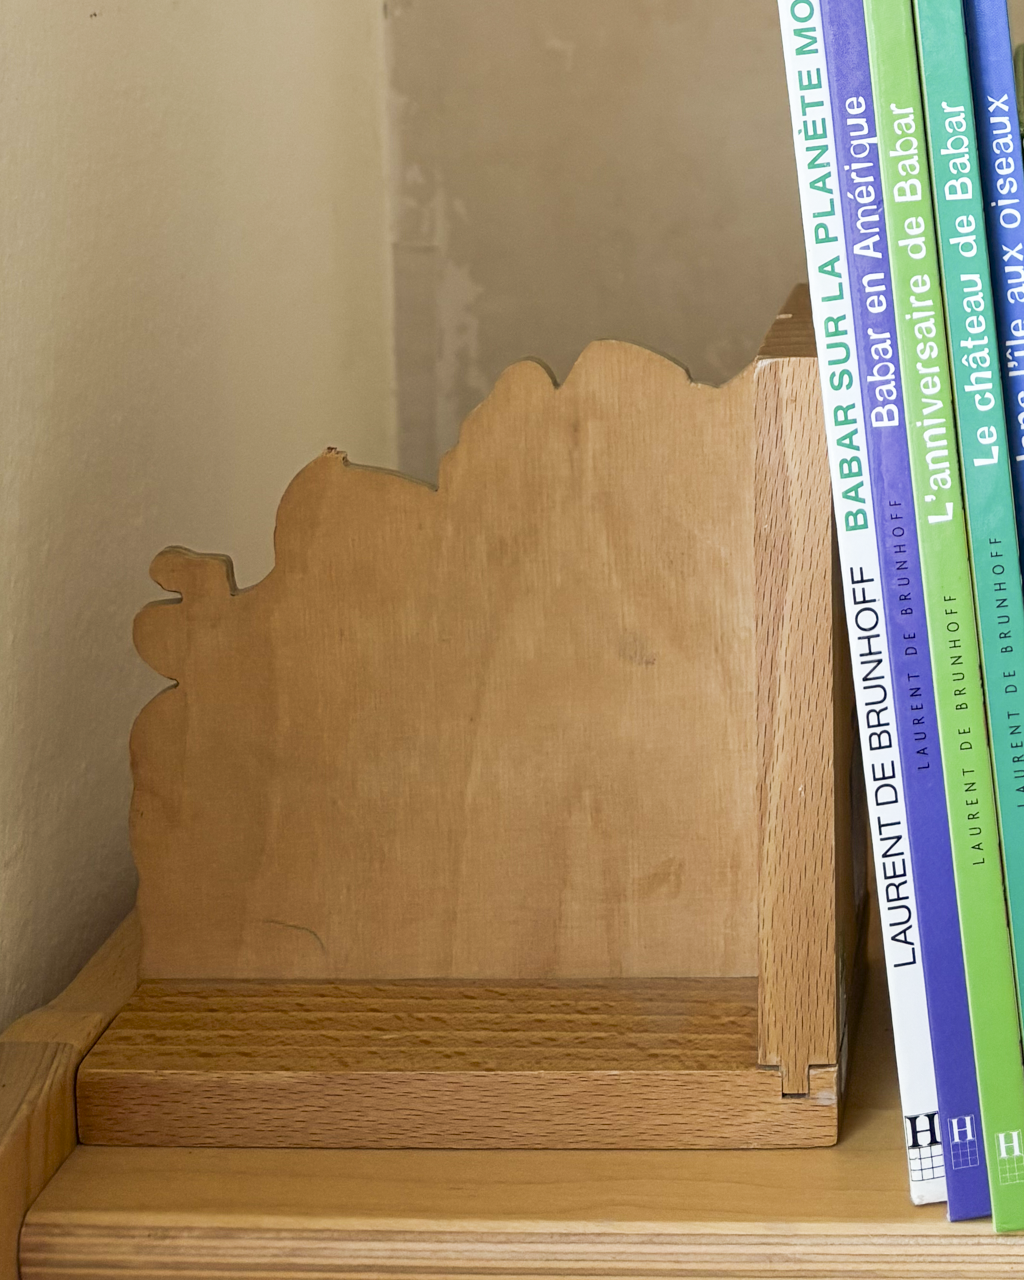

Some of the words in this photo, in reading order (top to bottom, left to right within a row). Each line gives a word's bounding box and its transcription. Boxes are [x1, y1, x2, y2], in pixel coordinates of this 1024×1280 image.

[798, 67, 839, 245] PLANÈTE
[845, 95, 883, 259] Amérique
[889, 103, 922, 203] Babar
[941, 101, 973, 201] Babar
[987, 93, 1021, 229] oiseaux
[818, 255, 845, 303] LA
[898, 216, 927, 259] de
[949, 214, 978, 258] de
[861, 272, 887, 313] en
[823, 314, 854, 391] SUR
[867, 327, 899, 428] Babar
[960, 273, 996, 412] château
[904, 273, 954, 525] L'anniversaire
[973, 425, 1000, 468] Le
[833, 402, 869, 532] BABAR
[889, 500, 914, 616] BRUNHOFF
[989, 537, 1014, 654] BRUNHOFF
[850, 566, 893, 752] BRUNHOFF
[903, 631, 918, 656] DE
[943, 594, 968, 711] BRUNHOFF
[1002, 669, 1018, 694] DE
[907, 672, 930, 770] LAURENT
[958, 726, 974, 751] DE
[872, 759, 899, 806] DE
[962, 767, 985, 866] LAURENT
[878, 815, 917, 968] LAURENT
[905, 1111, 942, 1148] H
[951, 1116, 975, 1143] H
[998, 1131, 1022, 1158] H
